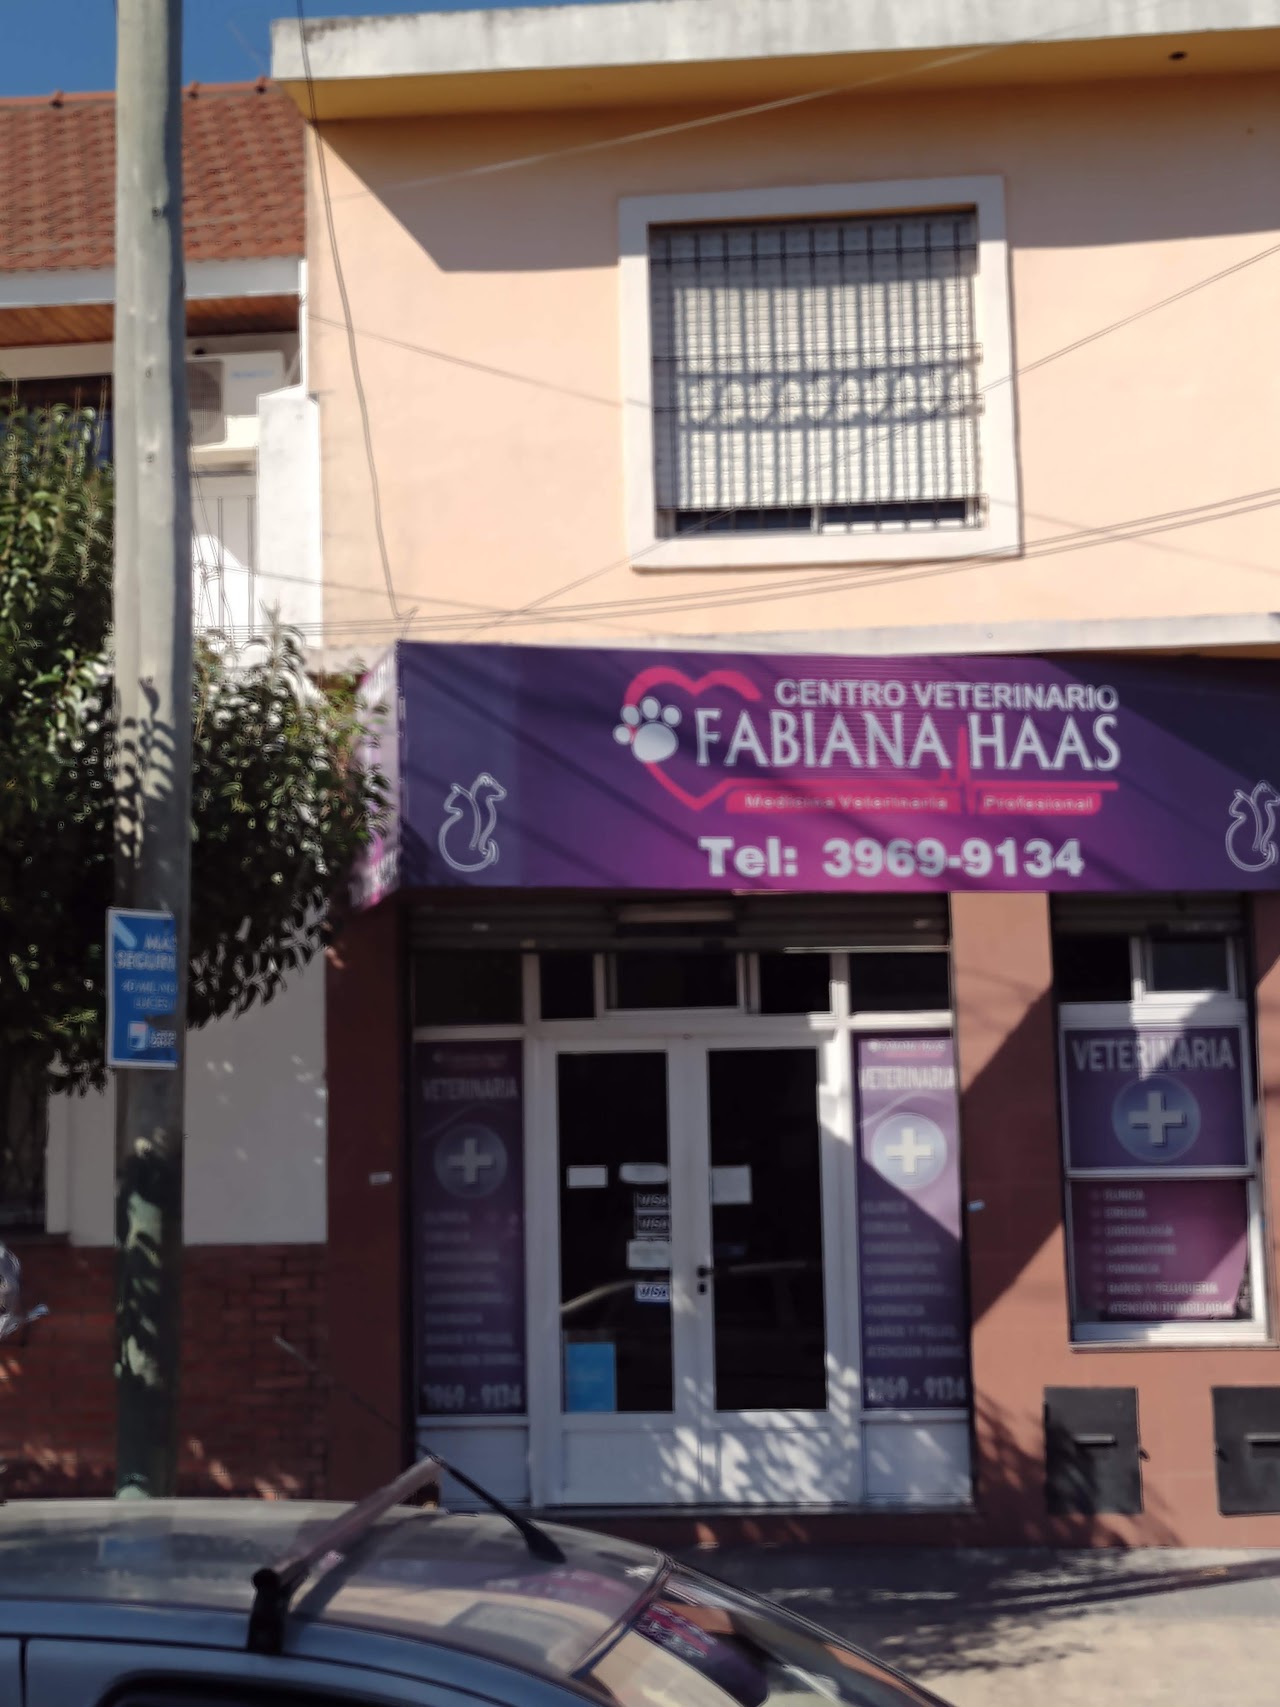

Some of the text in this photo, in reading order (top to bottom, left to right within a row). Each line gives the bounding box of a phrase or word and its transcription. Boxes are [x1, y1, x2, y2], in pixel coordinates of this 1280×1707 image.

[774, 679, 1120, 712] CENTRO VETERINARIO
[694, 707, 1121, 771] FABIANA HAAS
[839, 794, 949, 811] Veterinaria
[983, 795, 1095, 811] Profesional
[698, 836, 1086, 879] Tel: 3969-9134
[1072, 1037, 1235, 1071] VETERINARIA
[639, 1285, 668, 1297] VISA
